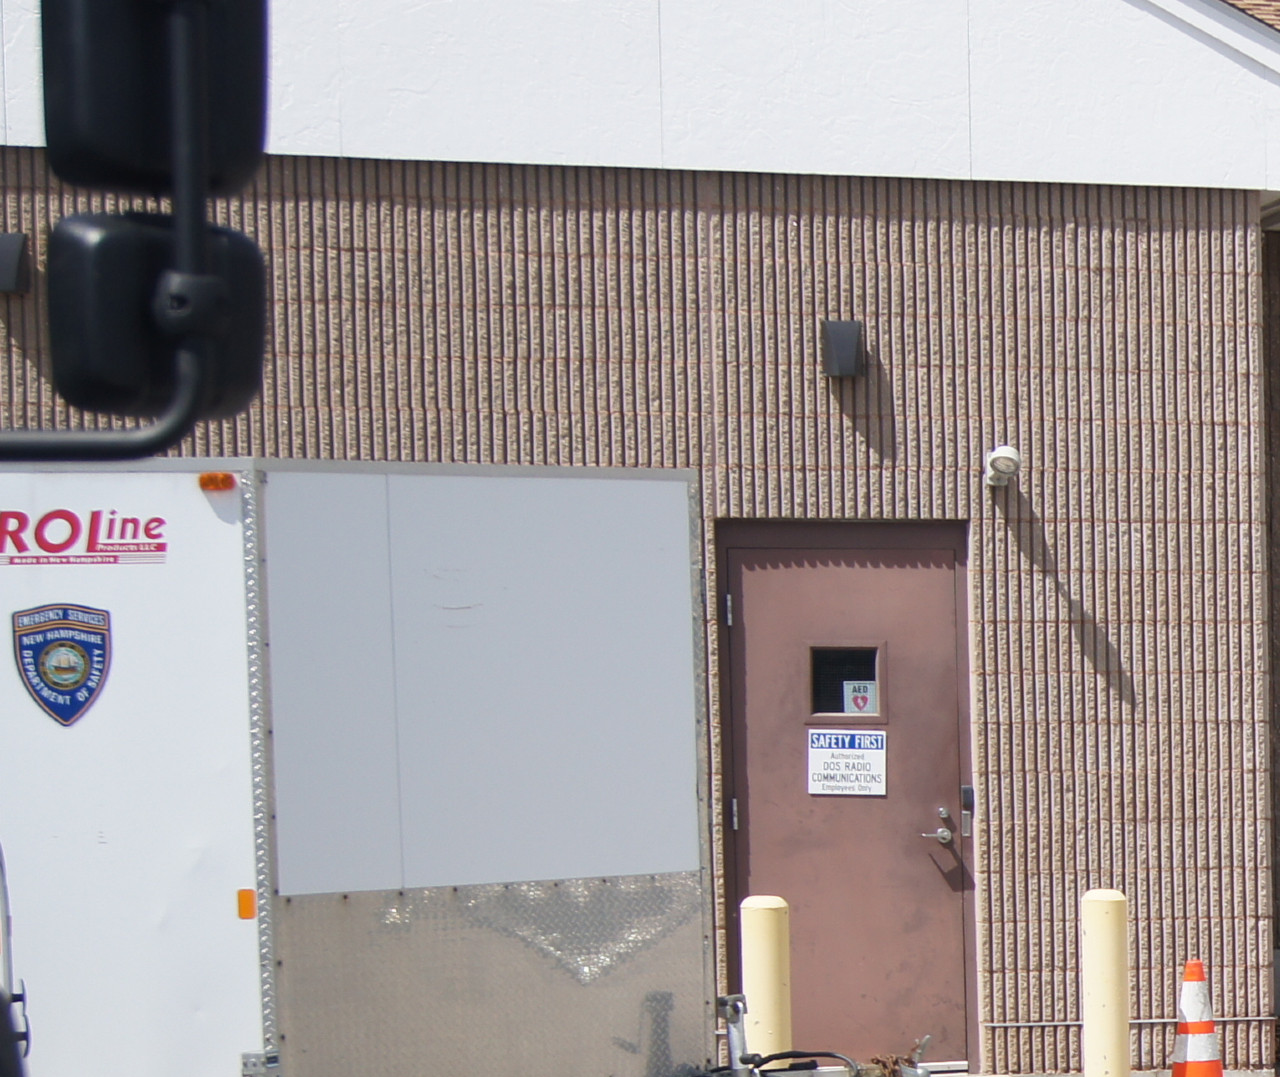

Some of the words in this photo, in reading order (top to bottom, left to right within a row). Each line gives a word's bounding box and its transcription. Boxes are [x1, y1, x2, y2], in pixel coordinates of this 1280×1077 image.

[18, 610, 64, 627] EMERGENCY
[68, 610, 105, 625] SERVICES
[22, 633, 46, 646] NEW
[46, 629, 104, 645] HAMPSHIRE
[22, 650, 72, 705] DEPARTMENT
[76, 688, 91, 702] OF
[88, 648, 104, 688] SAFETY
[852, 685, 869, 694] AED
[811, 734, 851, 749] SAFETY
[855, 735, 883, 749] FIRST
[830, 752, 865, 760] Authorized
[823, 762, 841, 771] DOS
[844, 762, 872, 772] RADIO
[812, 773, 882, 783] COMMUNICATIONS
[821, 784, 855, 792] Employees
[858, 784, 872, 792] Only
